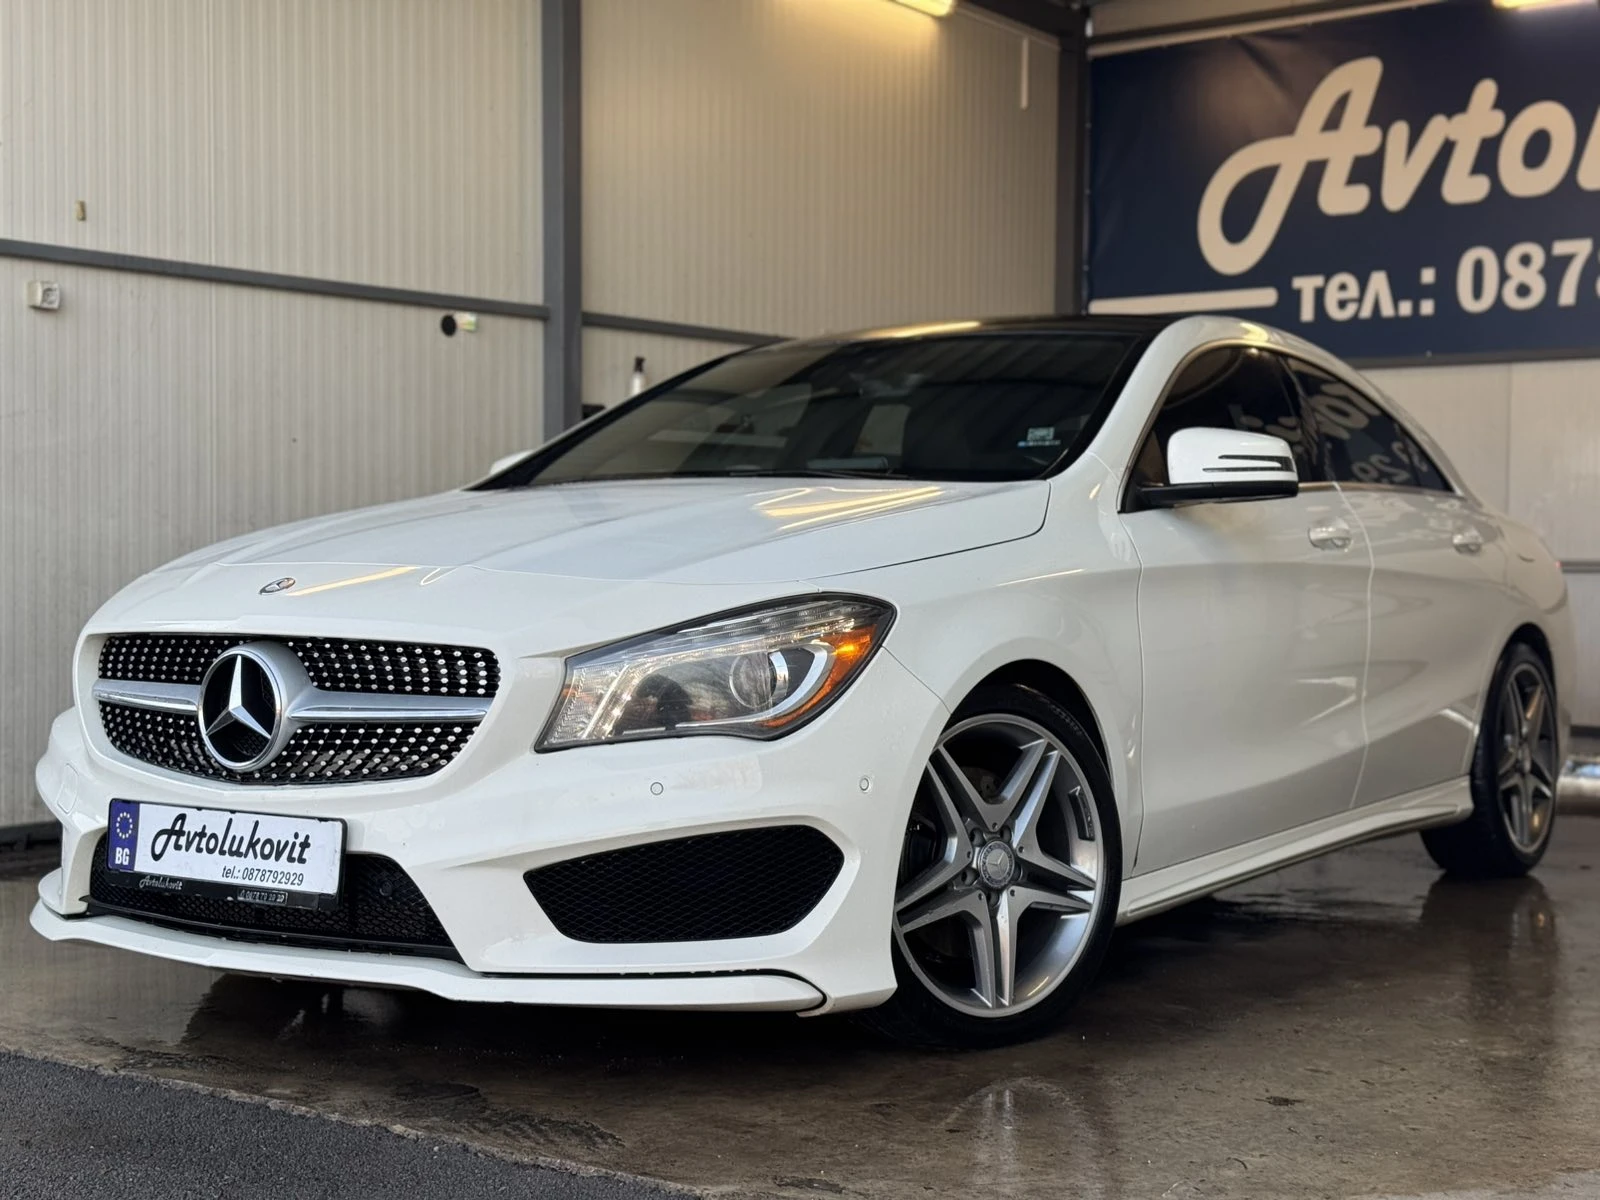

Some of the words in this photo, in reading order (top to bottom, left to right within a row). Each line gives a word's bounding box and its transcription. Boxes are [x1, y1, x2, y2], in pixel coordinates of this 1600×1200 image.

[1292, 267, 1436, 322] тел.:
[1456, 237, 1600, 313] 087
[151, 813, 311, 864] Avtolukovit
[115, 846, 130, 865] BG
[139, 875, 183, 890] Avtolukovit
[221, 865, 240, 879] tel.:
[241, 867, 304, 886] 0878792929
